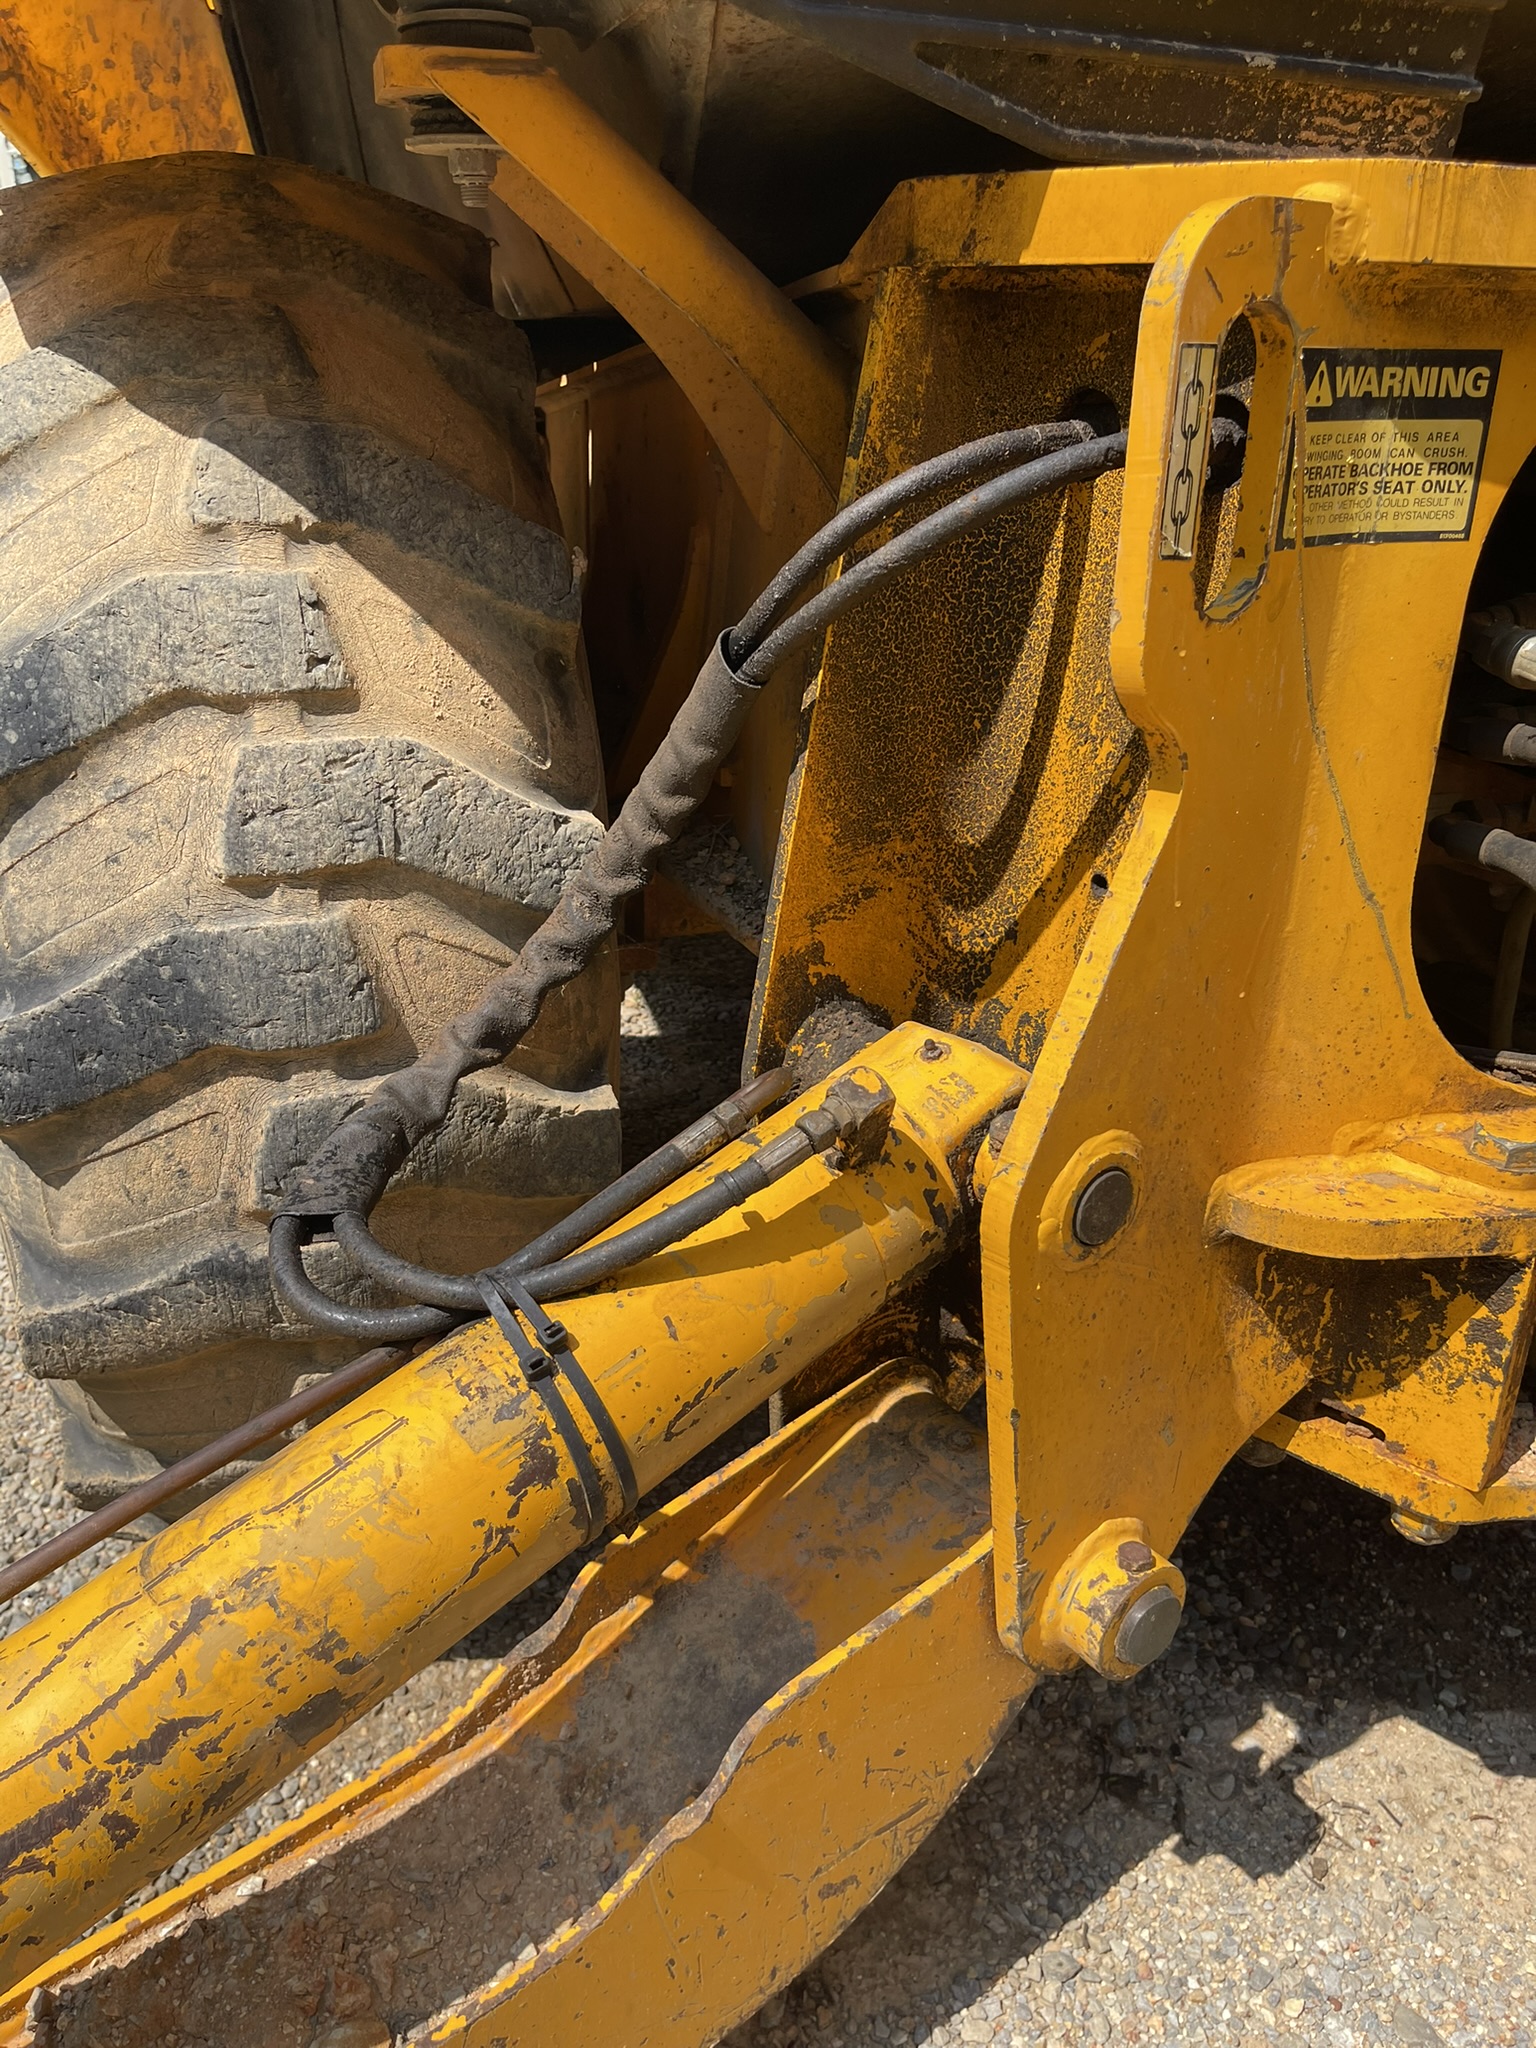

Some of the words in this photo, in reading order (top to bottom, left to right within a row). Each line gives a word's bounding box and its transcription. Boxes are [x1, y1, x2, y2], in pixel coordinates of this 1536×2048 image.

[1335, 366, 1491, 398] WARNING
[1310, 434, 1333, 446] KEEP
[1335, 433, 1367, 445] CLEAR
[1371, 432, 1386, 443] OF
[1393, 431, 1420, 443] THIS
[1427, 431, 1460, 442] AREA
[1305, 449, 1344, 463] WINGING
[1350, 448, 1382, 461] BOOM
[1390, 447, 1415, 459] CAN
[1423, 447, 1468, 458] CRUSH.
[1349, 462, 1423, 478] BACKHOE
[1428, 461, 1474, 477] FROM
[1373, 480, 1416, 496] SEAT
[1422, 479, 1468, 495] ONLY.
[1309, 501, 1334, 513] OTHER
[1413, 497, 1450, 508] RESULT
[1454, 496, 1464, 507] IN
[1316, 514, 1326, 525] TO
[1328, 511, 1372, 524] OPERATOR
